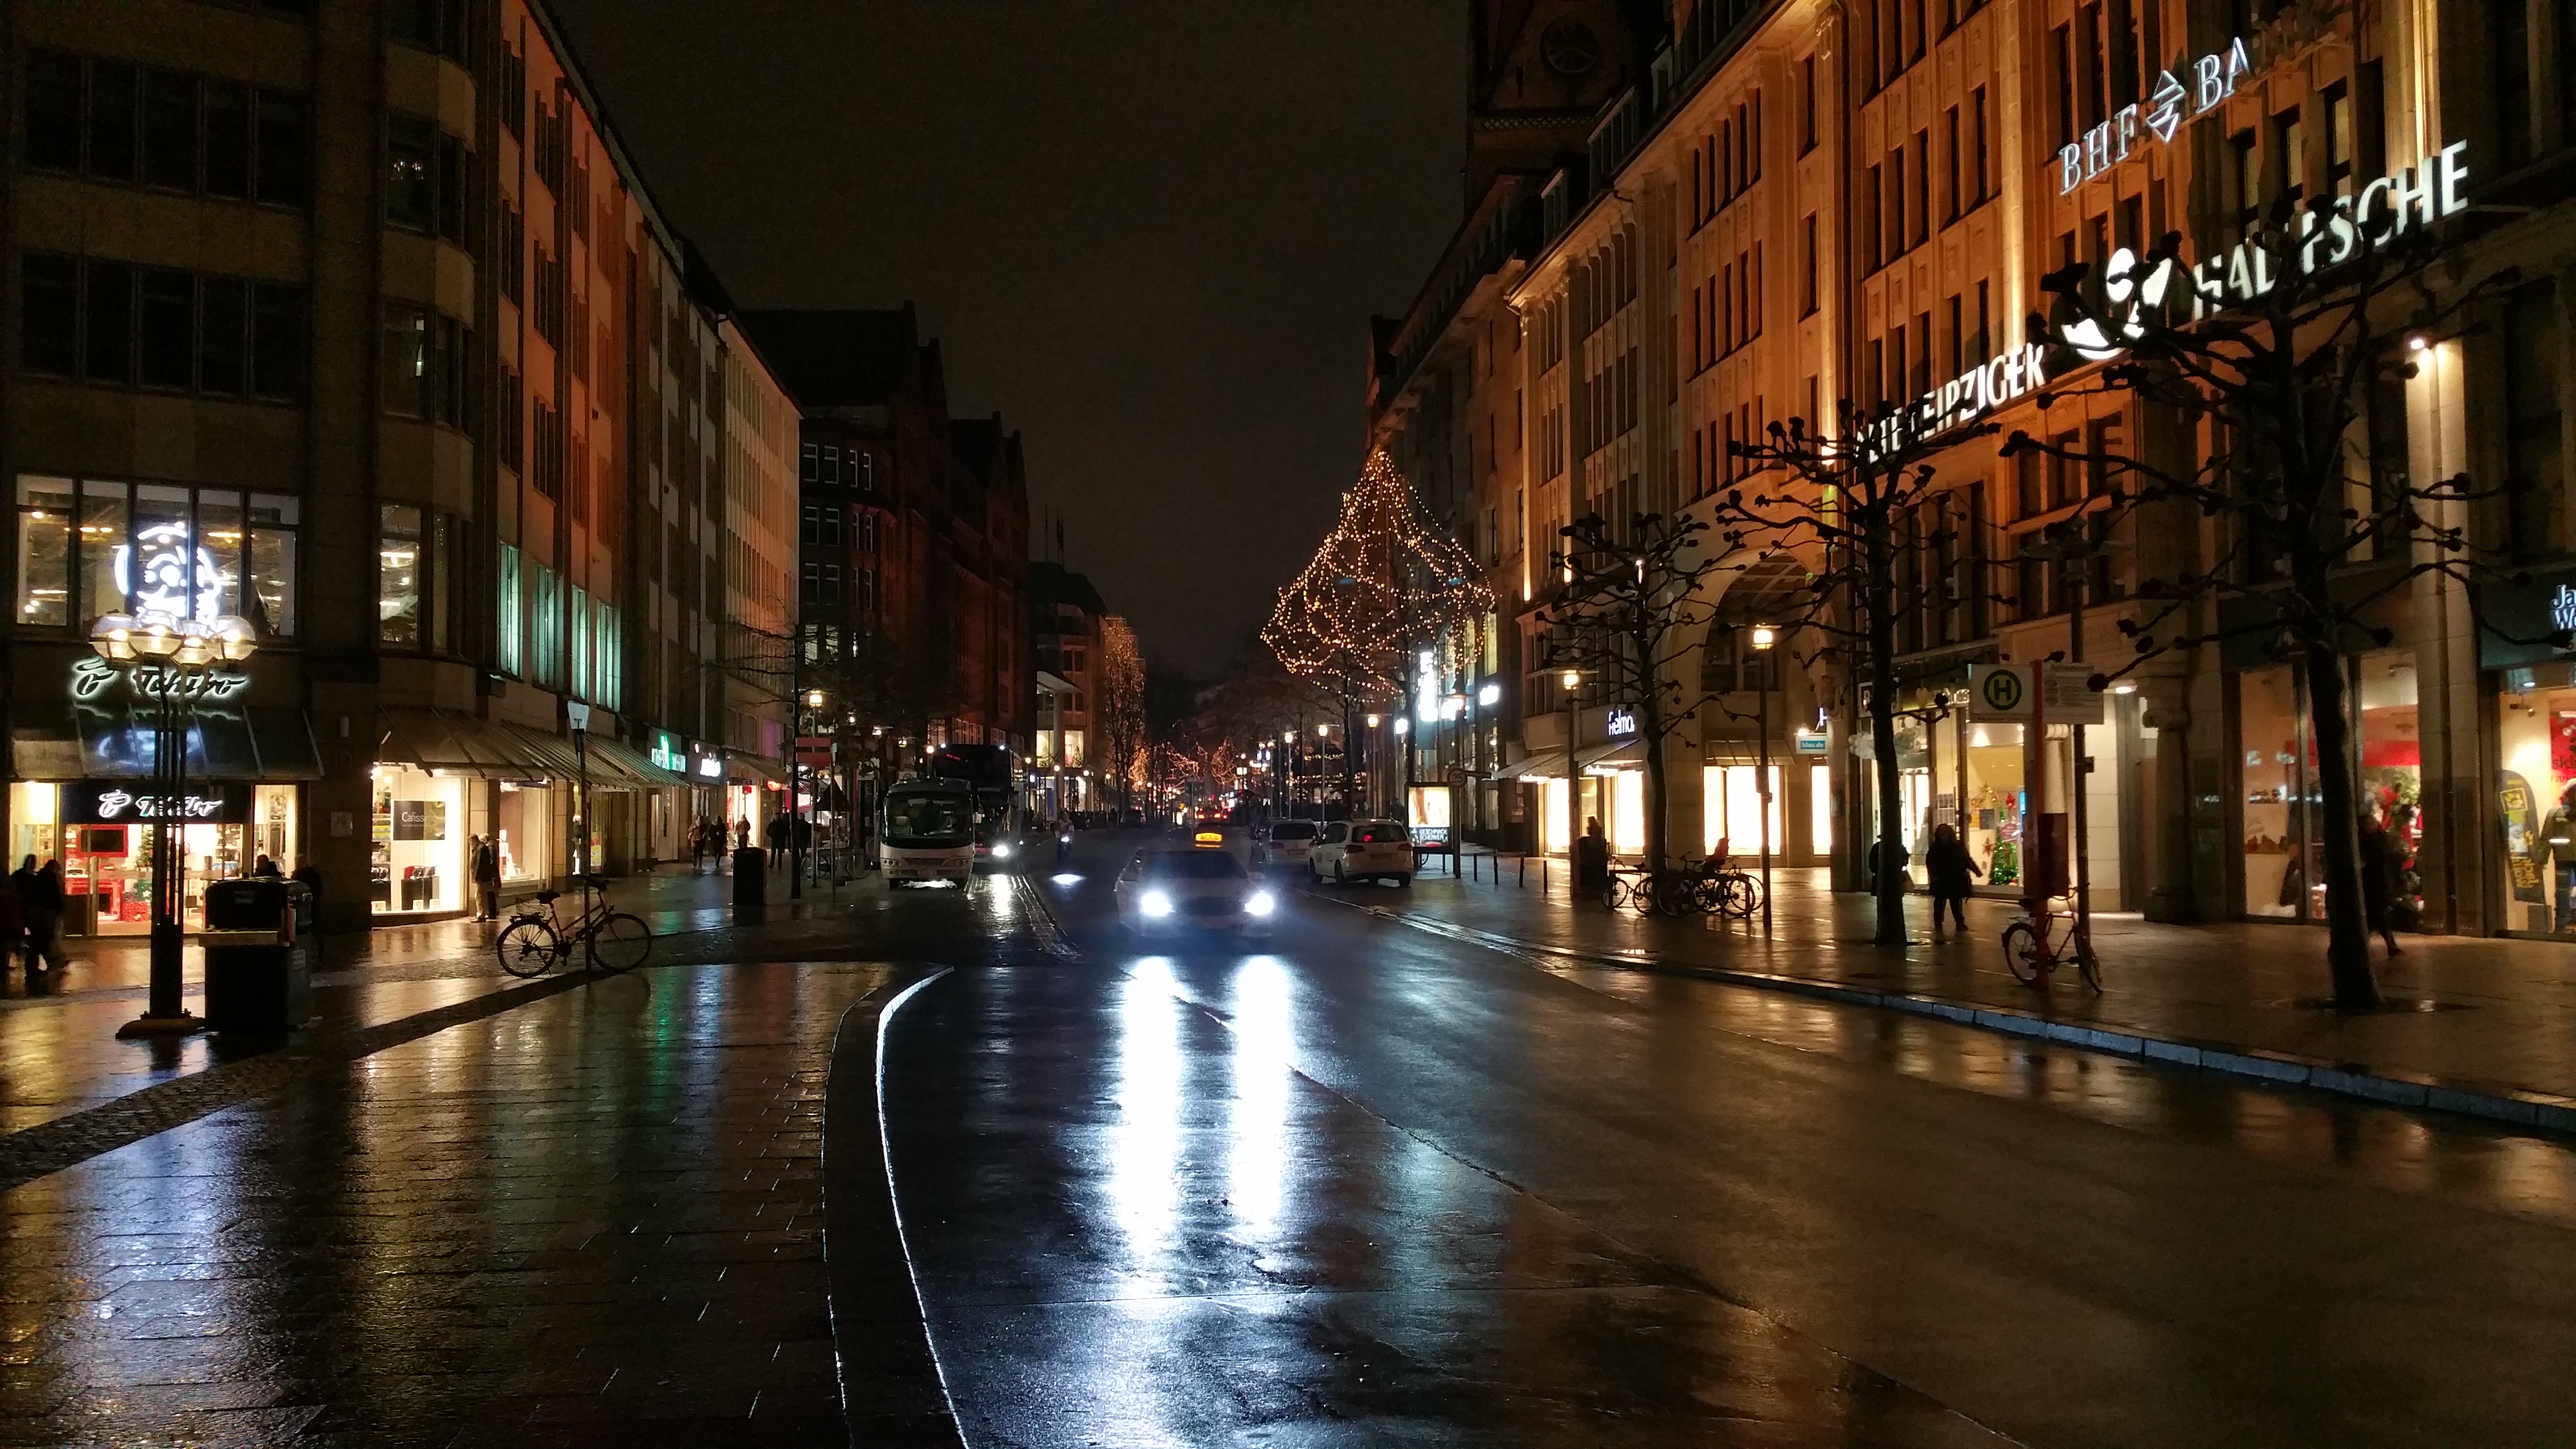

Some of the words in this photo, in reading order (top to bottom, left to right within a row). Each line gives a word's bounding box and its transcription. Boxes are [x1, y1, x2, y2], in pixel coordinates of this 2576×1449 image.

[2059, 103, 2137, 195] BHF
[2193, 37, 2250, 114] BA
[2193, 139, 2468, 320] HALESCHE
[1994, 679, 2011, 701] H
[1452, 773, 1463, 783] 25
